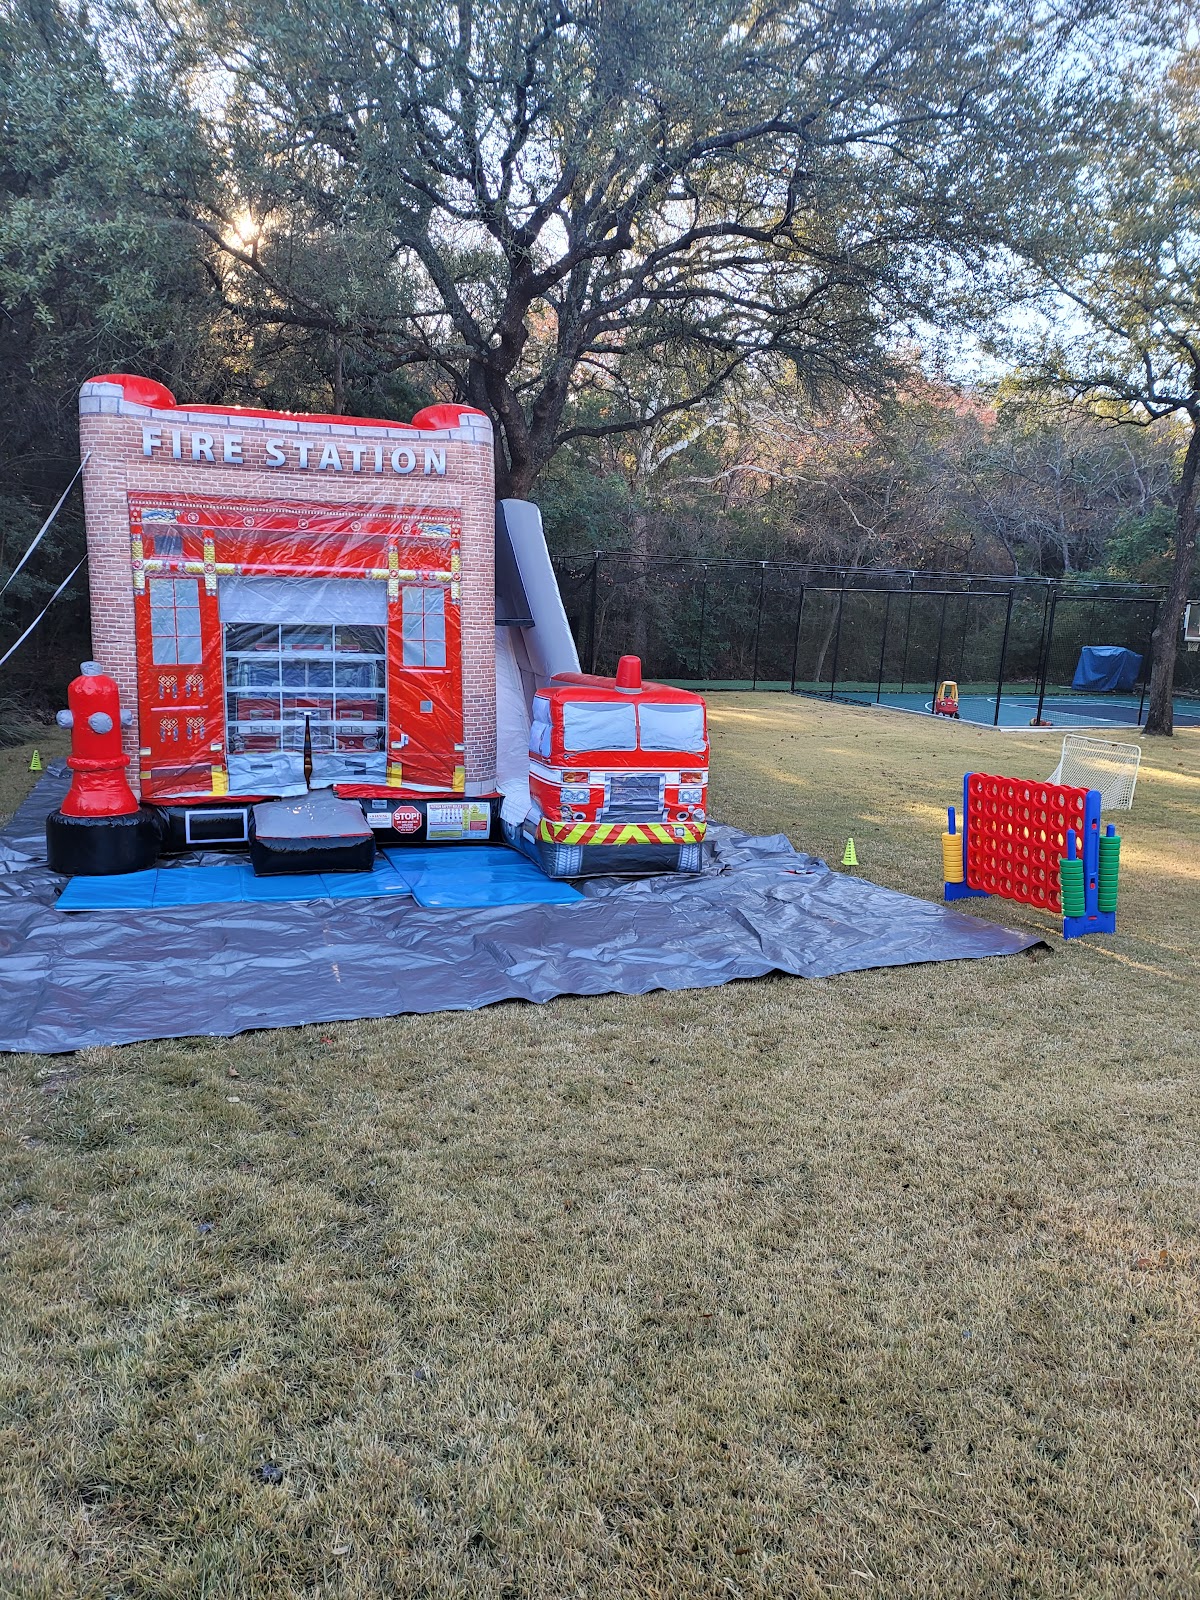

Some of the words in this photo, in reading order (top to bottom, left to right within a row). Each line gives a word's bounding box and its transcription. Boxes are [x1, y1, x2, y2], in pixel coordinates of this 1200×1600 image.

[142, 426, 244, 464] FIRE
[265, 437, 447, 475] STATION
[394, 812, 420, 820] STOP!
